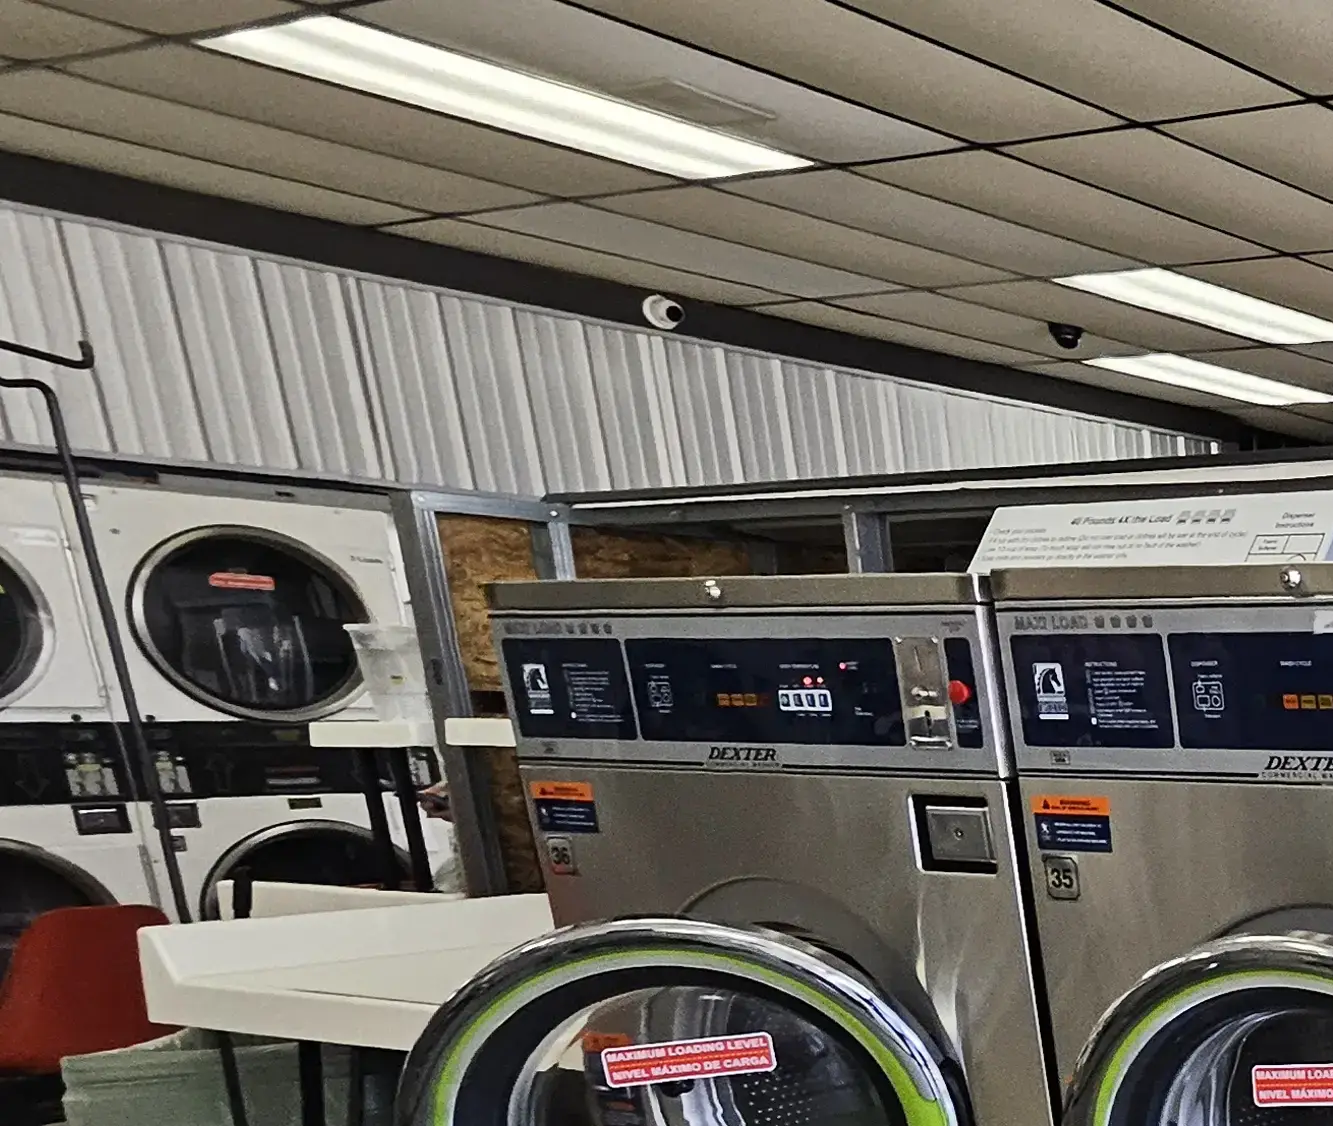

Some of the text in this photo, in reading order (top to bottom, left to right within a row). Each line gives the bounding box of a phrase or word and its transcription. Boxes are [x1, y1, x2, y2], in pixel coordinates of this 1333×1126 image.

[1149, 514, 1173, 524] Load
[708, 746, 777, 762] DEXTER
[550, 846, 571, 866] 36
[1050, 868, 1074, 889] 35
[605, 1037, 768, 1063] MAXIMUM LOADING LEVEL
[612, 1054, 770, 1081] NIVEL MÁXIMO DE CARGA
[1256, 1070, 1306, 1080] MAXIMUM
[1258, 1090, 1290, 1100] NIVEL
[1290, 1088, 1333, 1100] MÁXIMO
